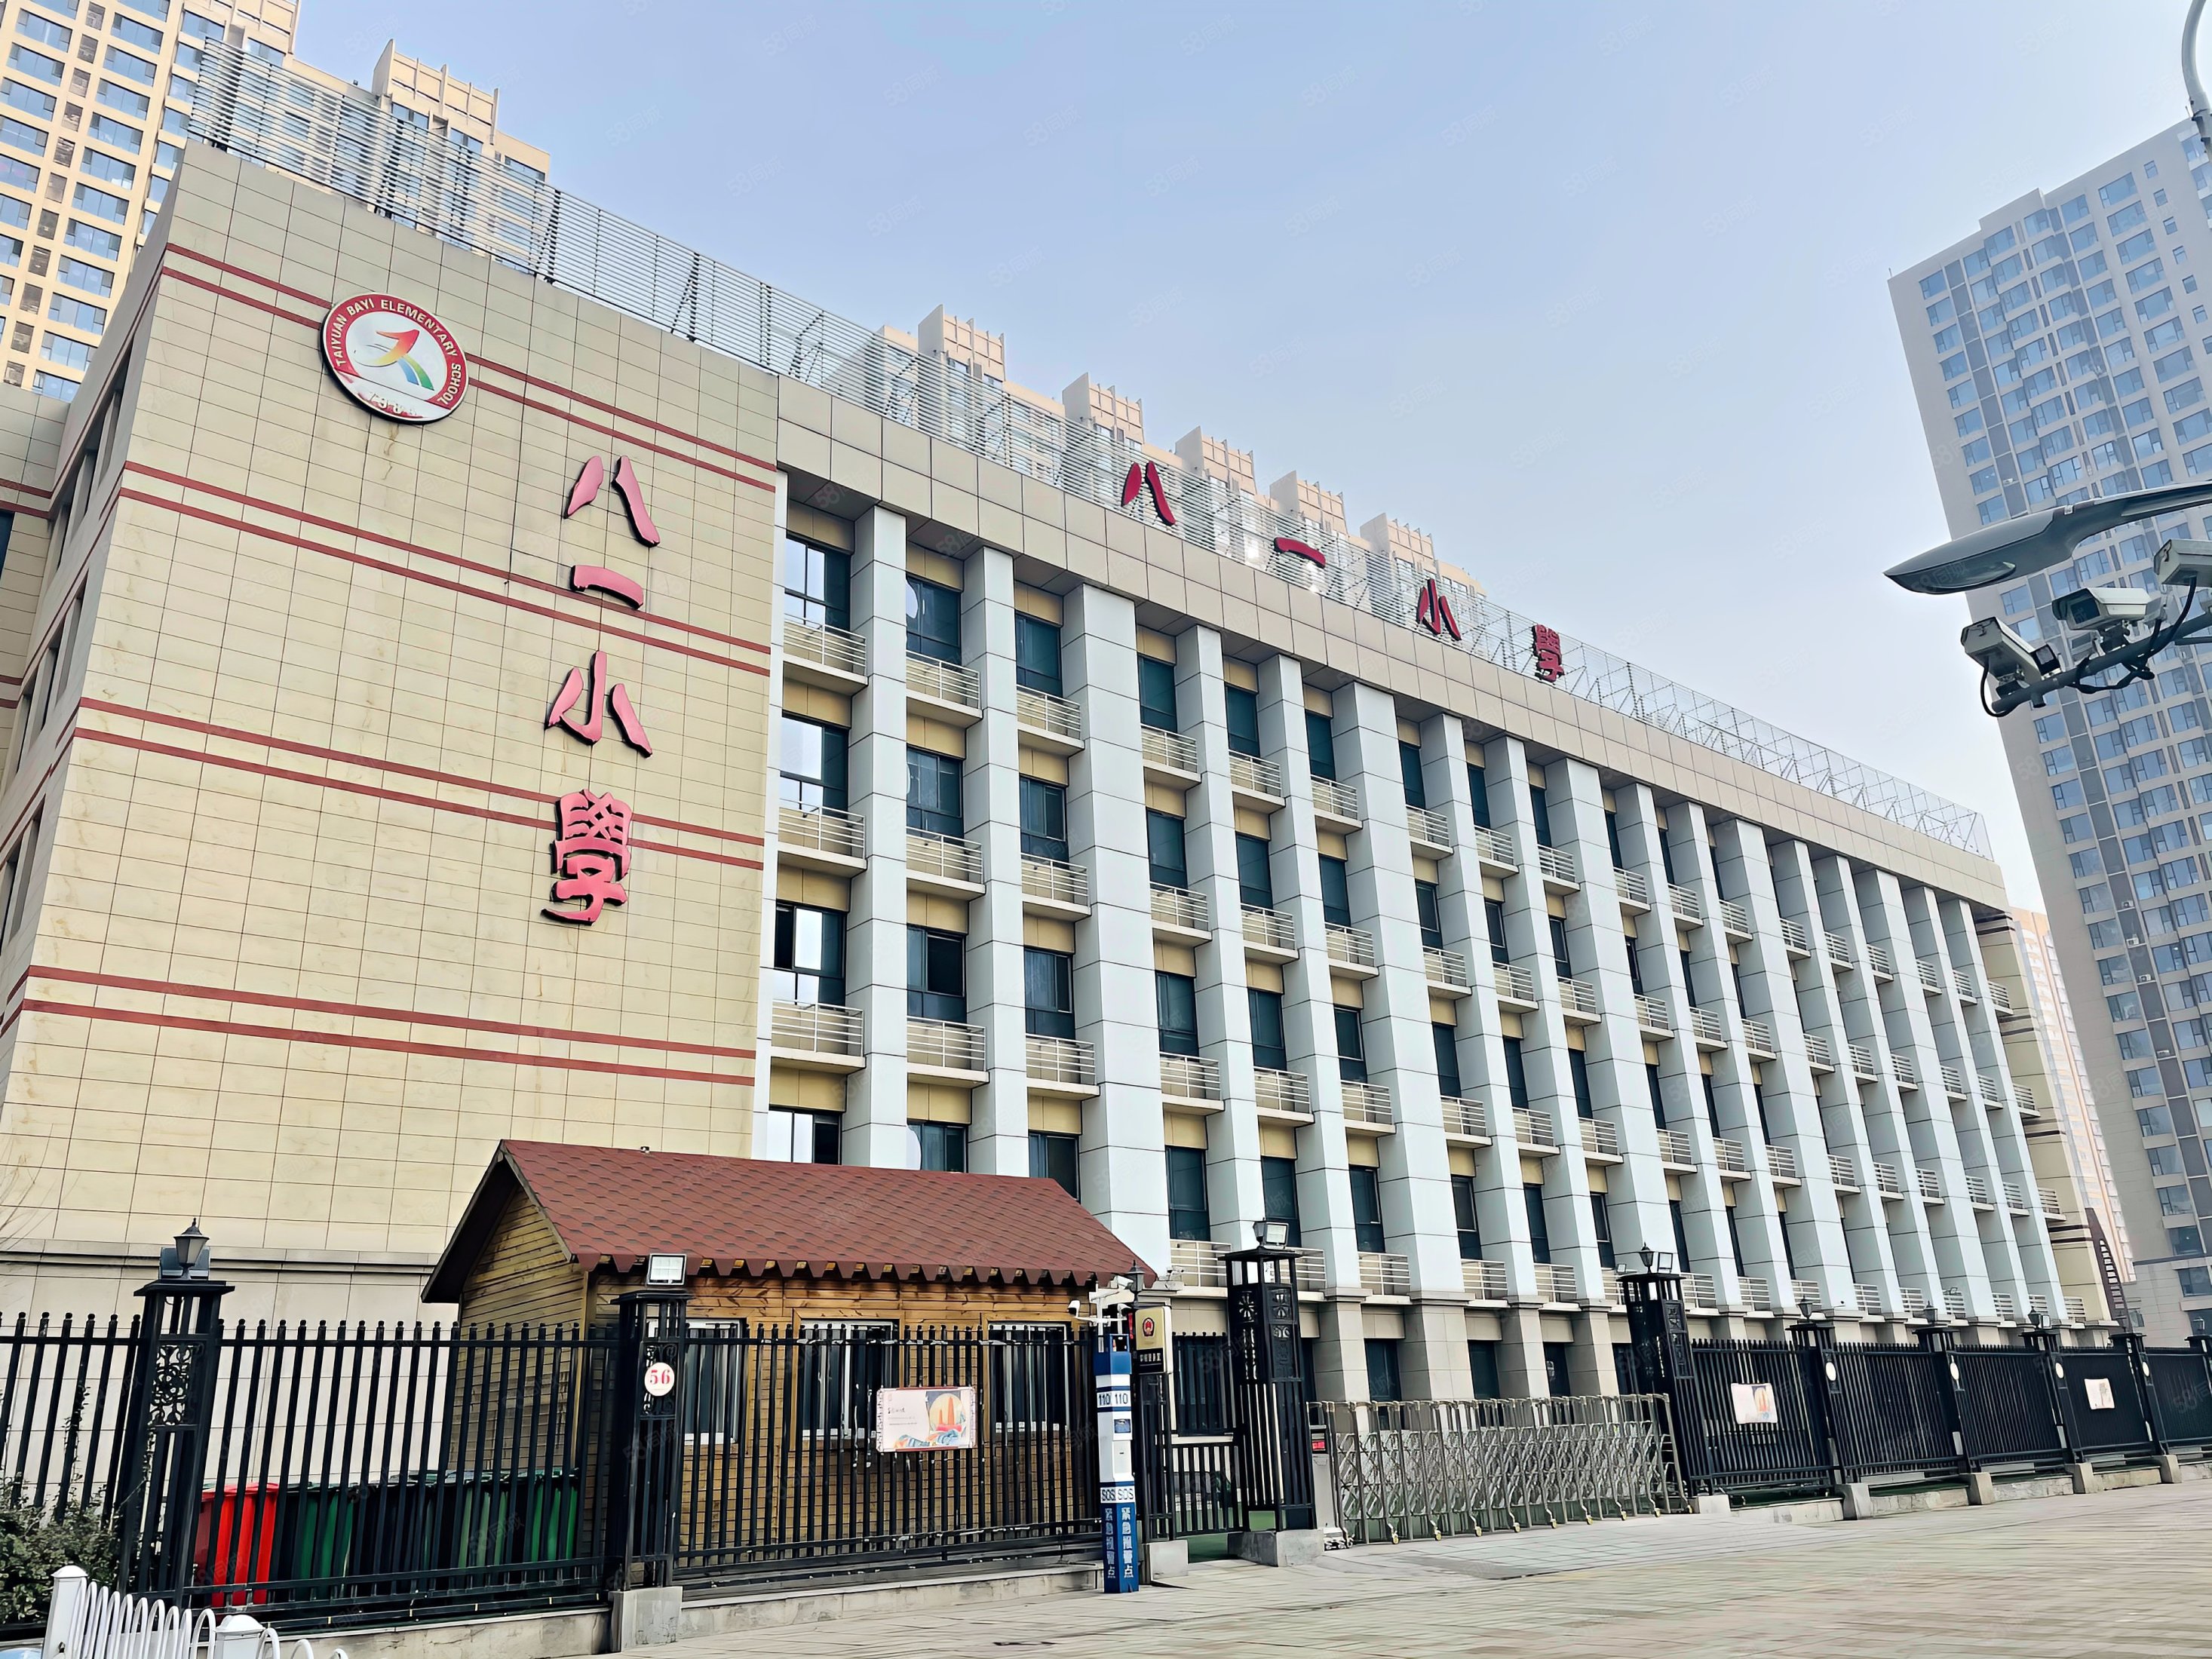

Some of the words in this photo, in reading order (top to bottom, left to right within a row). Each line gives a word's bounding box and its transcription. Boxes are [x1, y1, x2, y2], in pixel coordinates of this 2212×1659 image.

[331, 314, 347, 366] TAIYUAN
[346, 298, 375, 315] BAYI
[381, 299, 458, 357] ELEMENTARY
[437, 363, 462, 405] SCHOOL
[1121, 460, 1565, 682] 八一小學
[540, 455, 661, 926] 八一小學
[650, 1369, 670, 1385] 56
[1098, 1394, 1111, 1406] 110
[1114, 1393, 1128, 1405] 110
[1118, 1489, 1134, 1501] SOS
